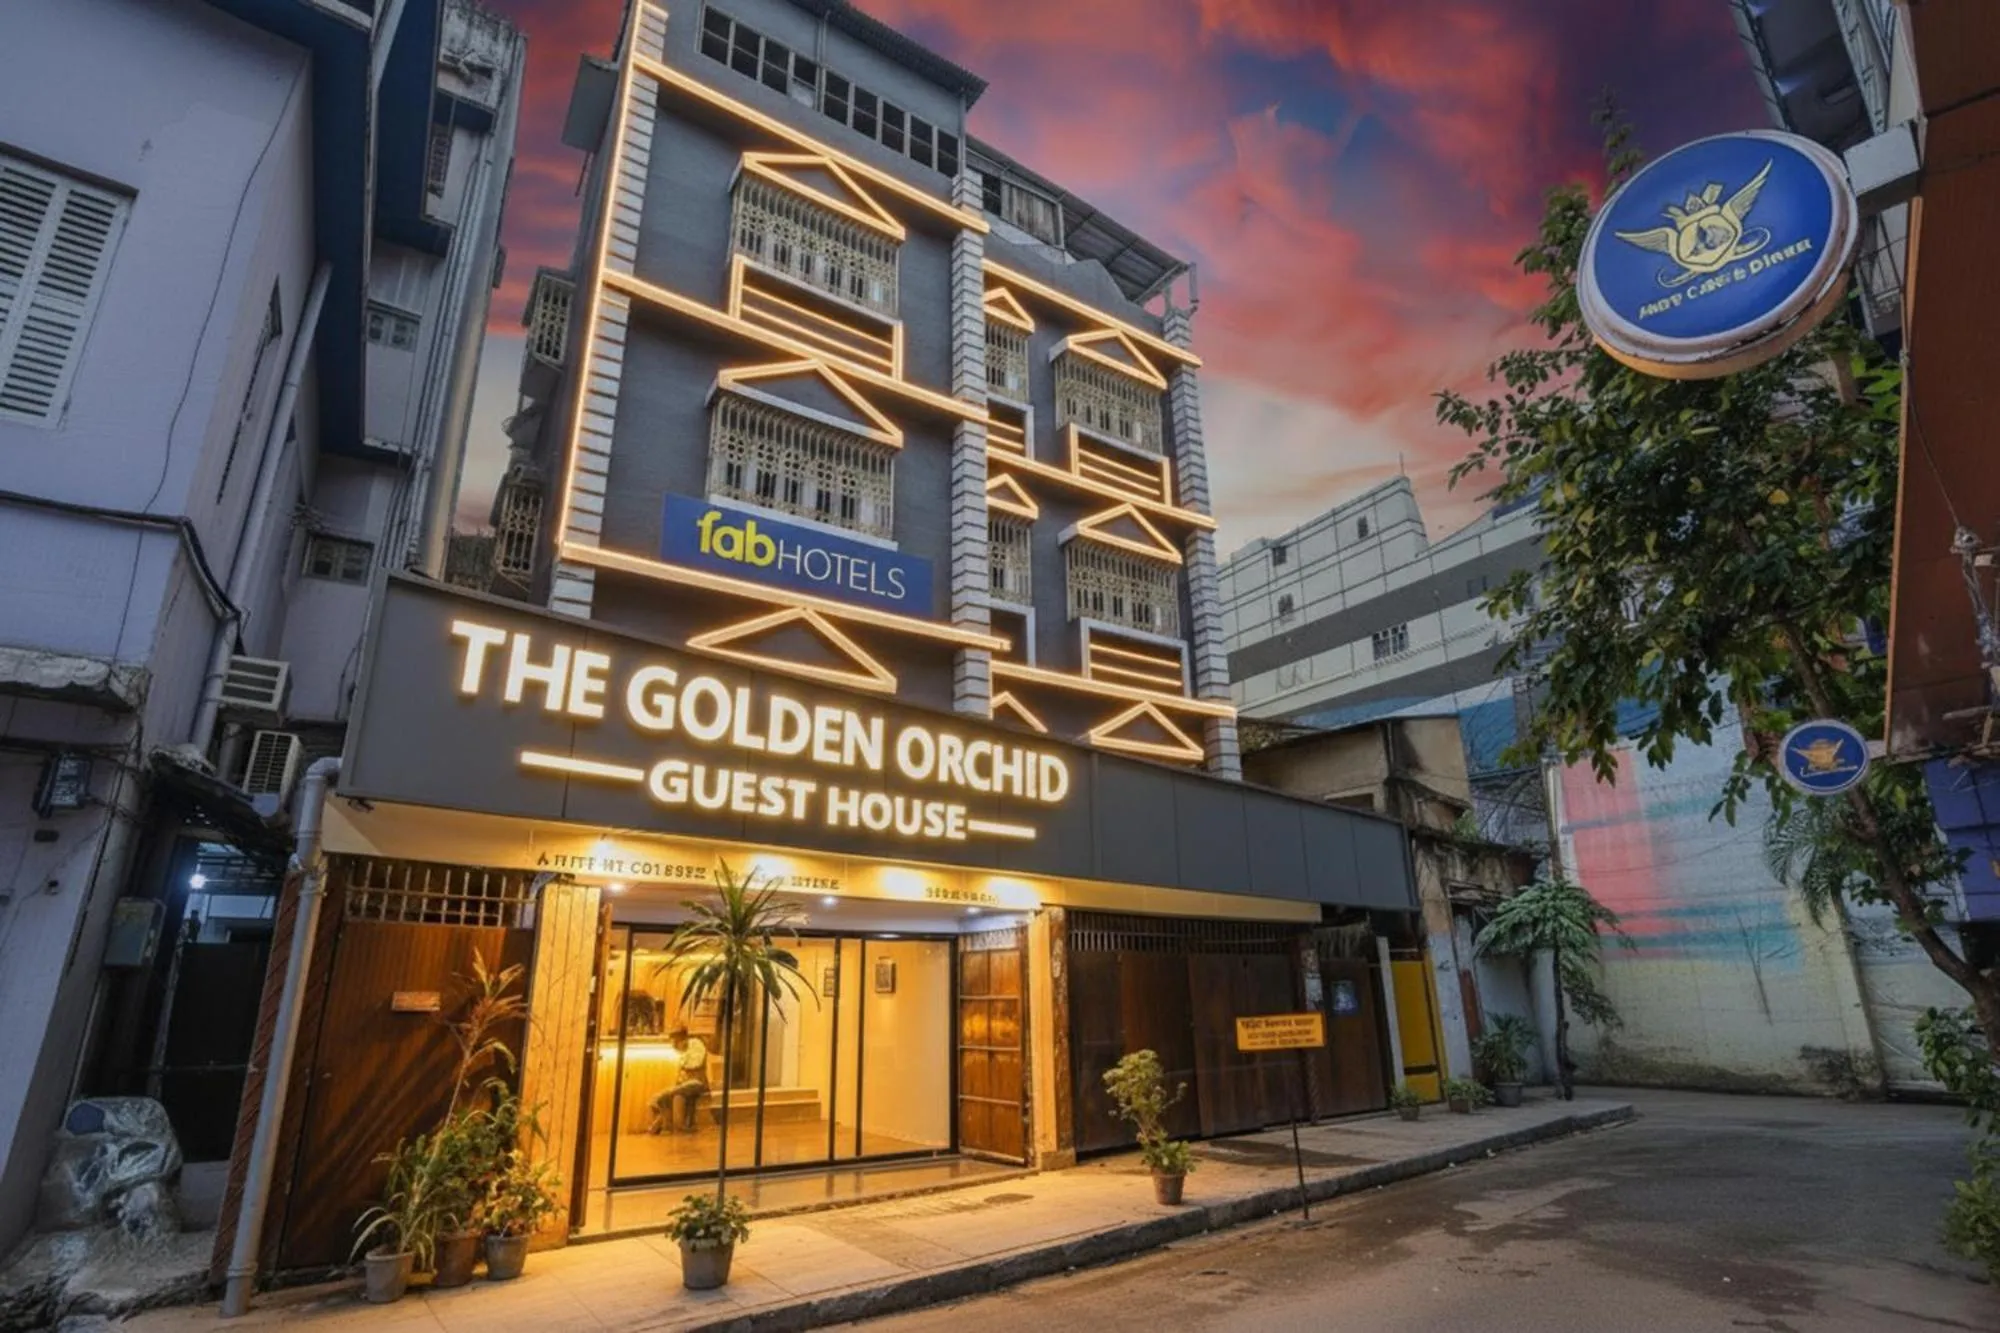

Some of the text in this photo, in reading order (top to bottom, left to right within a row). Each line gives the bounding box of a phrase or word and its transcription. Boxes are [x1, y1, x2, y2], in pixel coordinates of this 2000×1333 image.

[451, 620, 1069, 801] THE GOLDEN ORCHID
[649, 760, 967, 840] GUEST HOUSE
